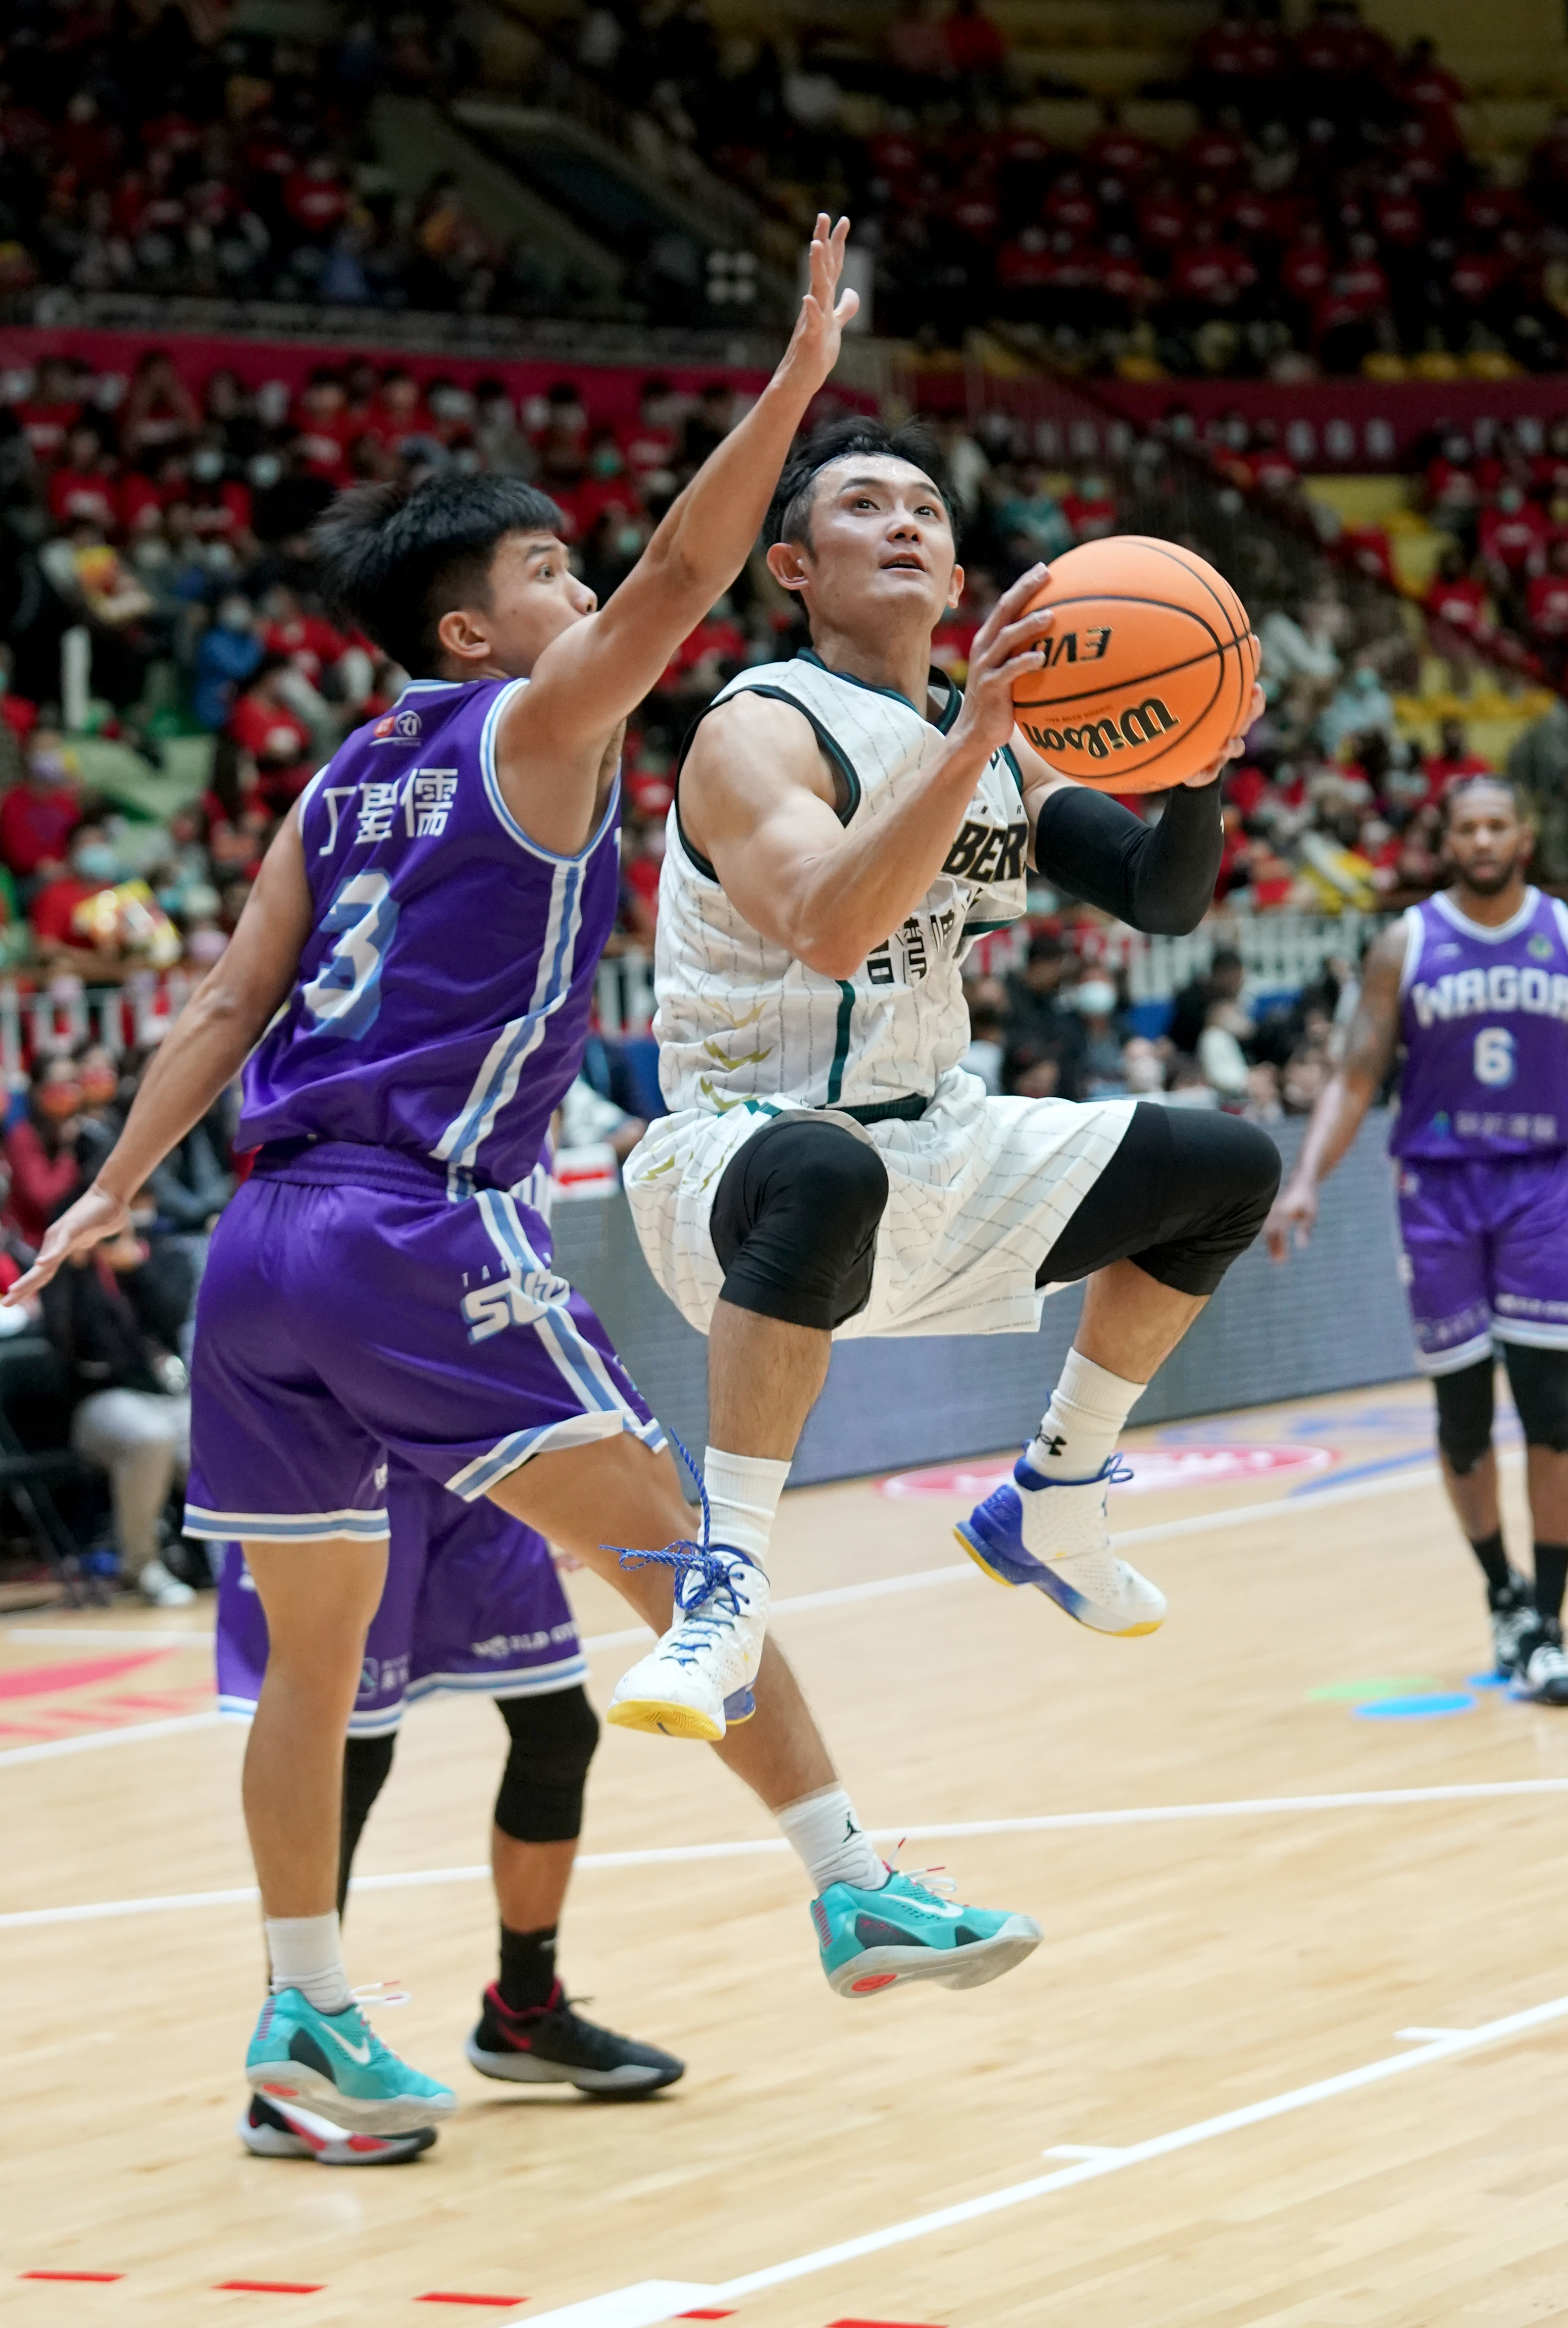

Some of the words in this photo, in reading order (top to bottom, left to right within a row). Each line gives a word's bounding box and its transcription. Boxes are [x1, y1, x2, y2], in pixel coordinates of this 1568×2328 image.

[1023, 697, 1181, 759] Wilson
[319, 768, 458, 857] 丁聖儒
[302, 868, 400, 1042] 3
[1474, 1026, 1514, 1086] 6
